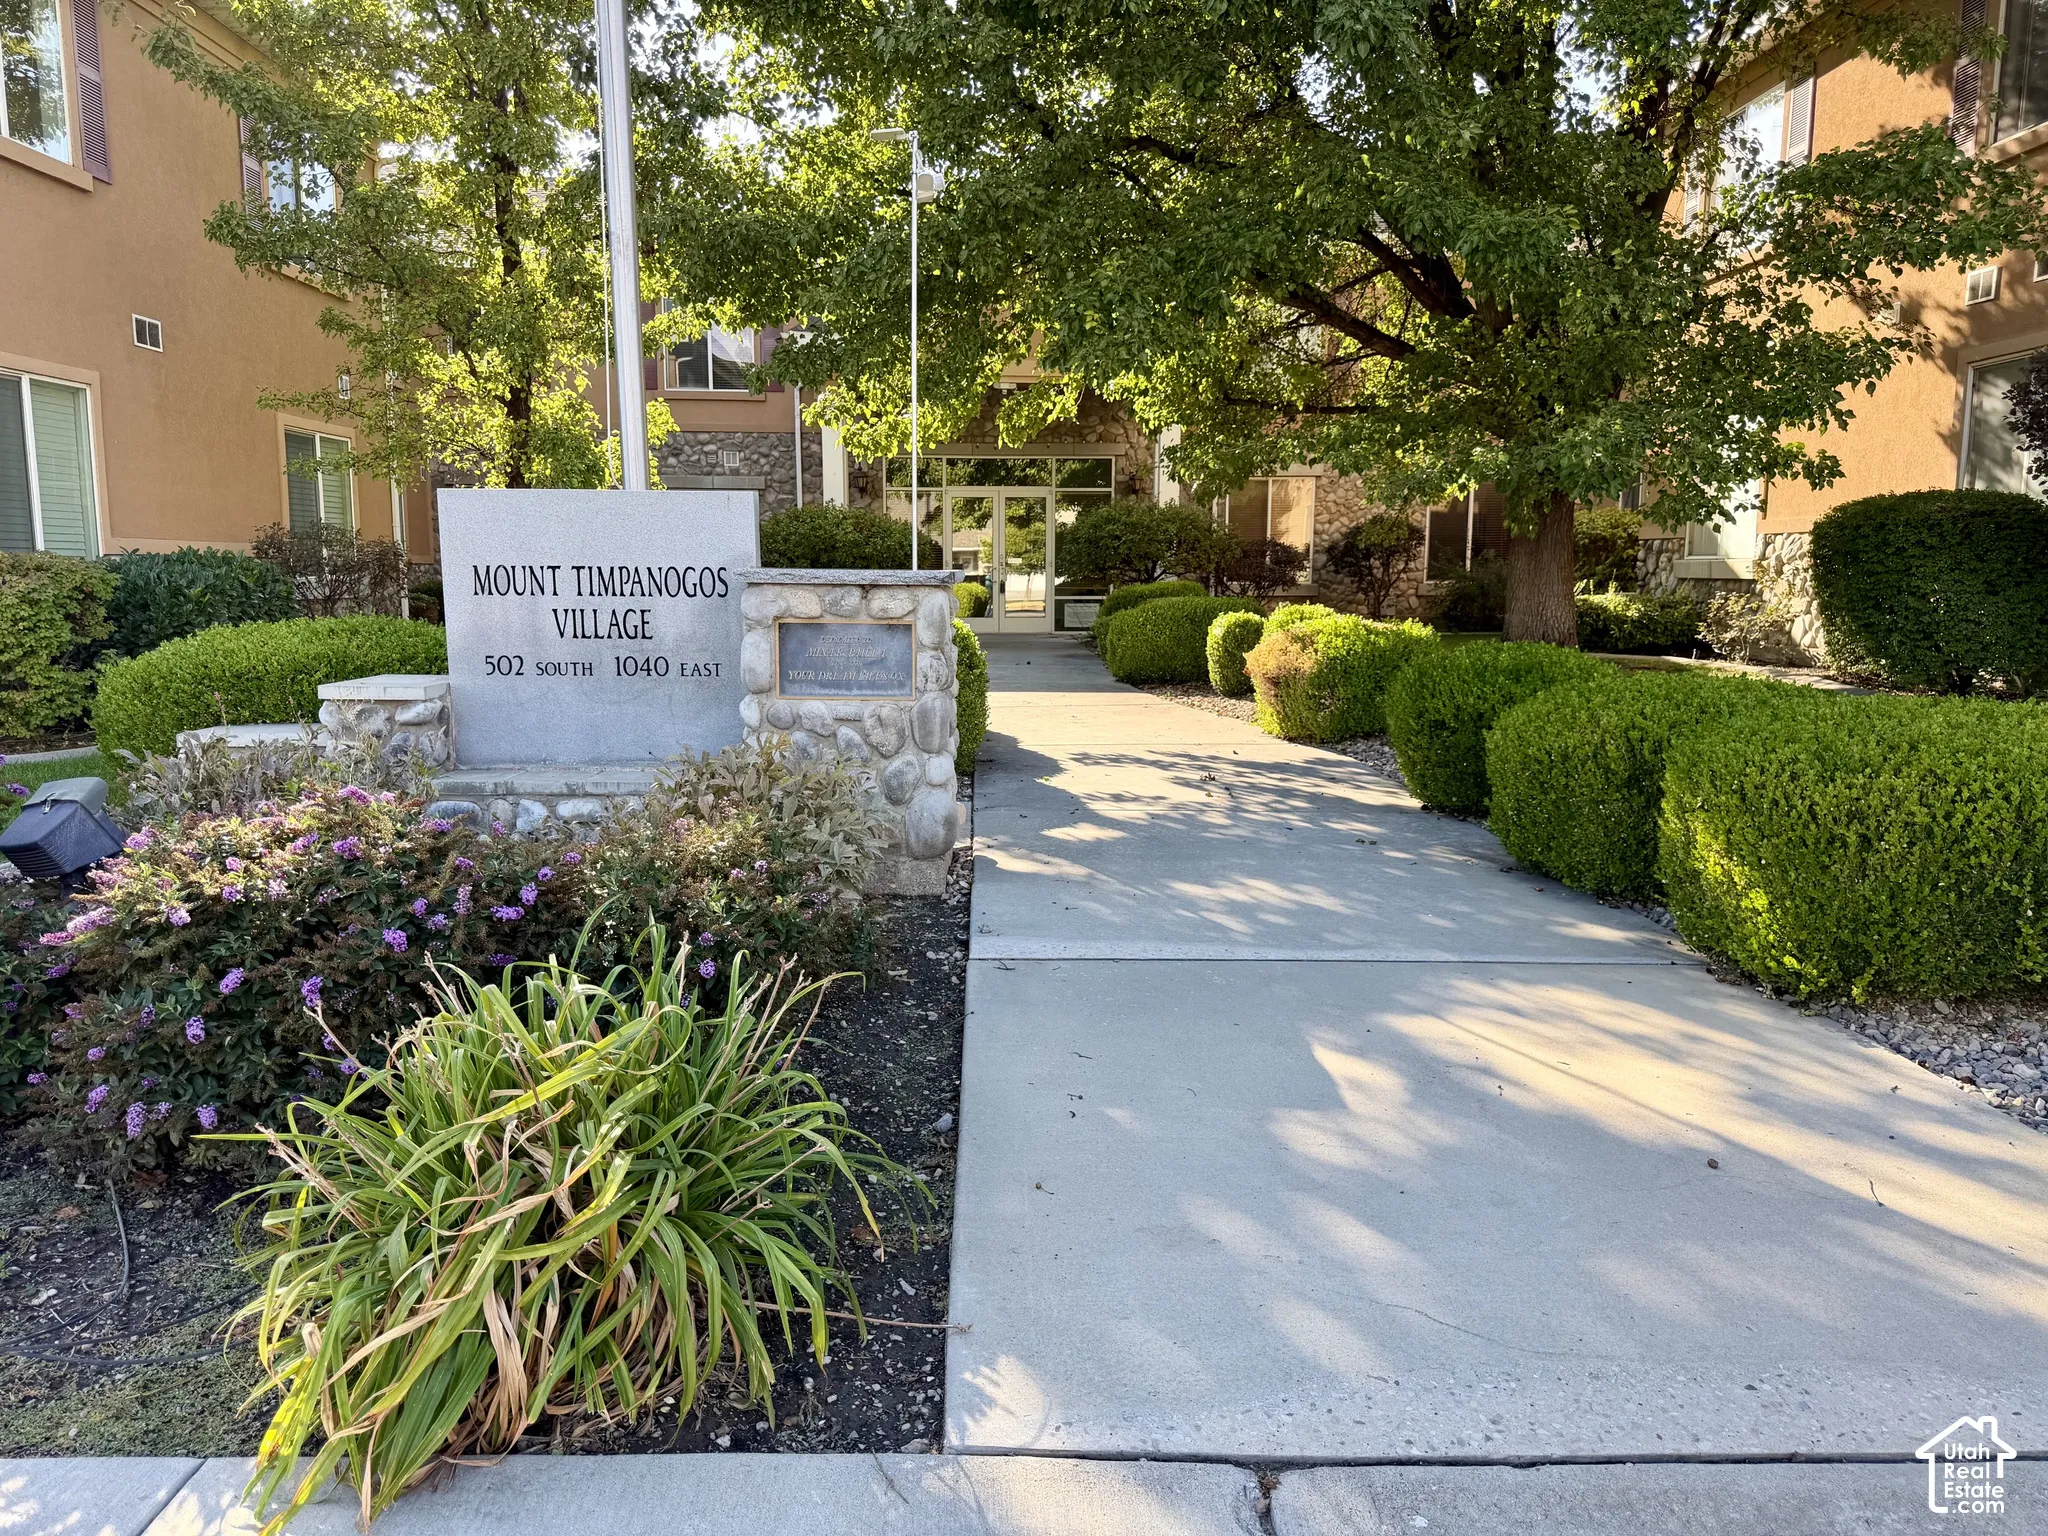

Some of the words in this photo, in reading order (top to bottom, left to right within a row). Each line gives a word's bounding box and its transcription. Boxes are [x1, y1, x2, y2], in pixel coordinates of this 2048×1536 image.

[472, 564, 562, 597] MOUNT
[570, 565, 729, 599] TIMPANOGOS
[552, 608, 654, 640] VILLAGE
[485, 655, 525, 677] 502
[536, 661, 594, 677] SOUTH
[615, 655, 670, 677] 1040
[680, 662, 722, 677] EAST
[788, 670, 816, 680] YOUR
[817, 670, 856, 681] DREAM
